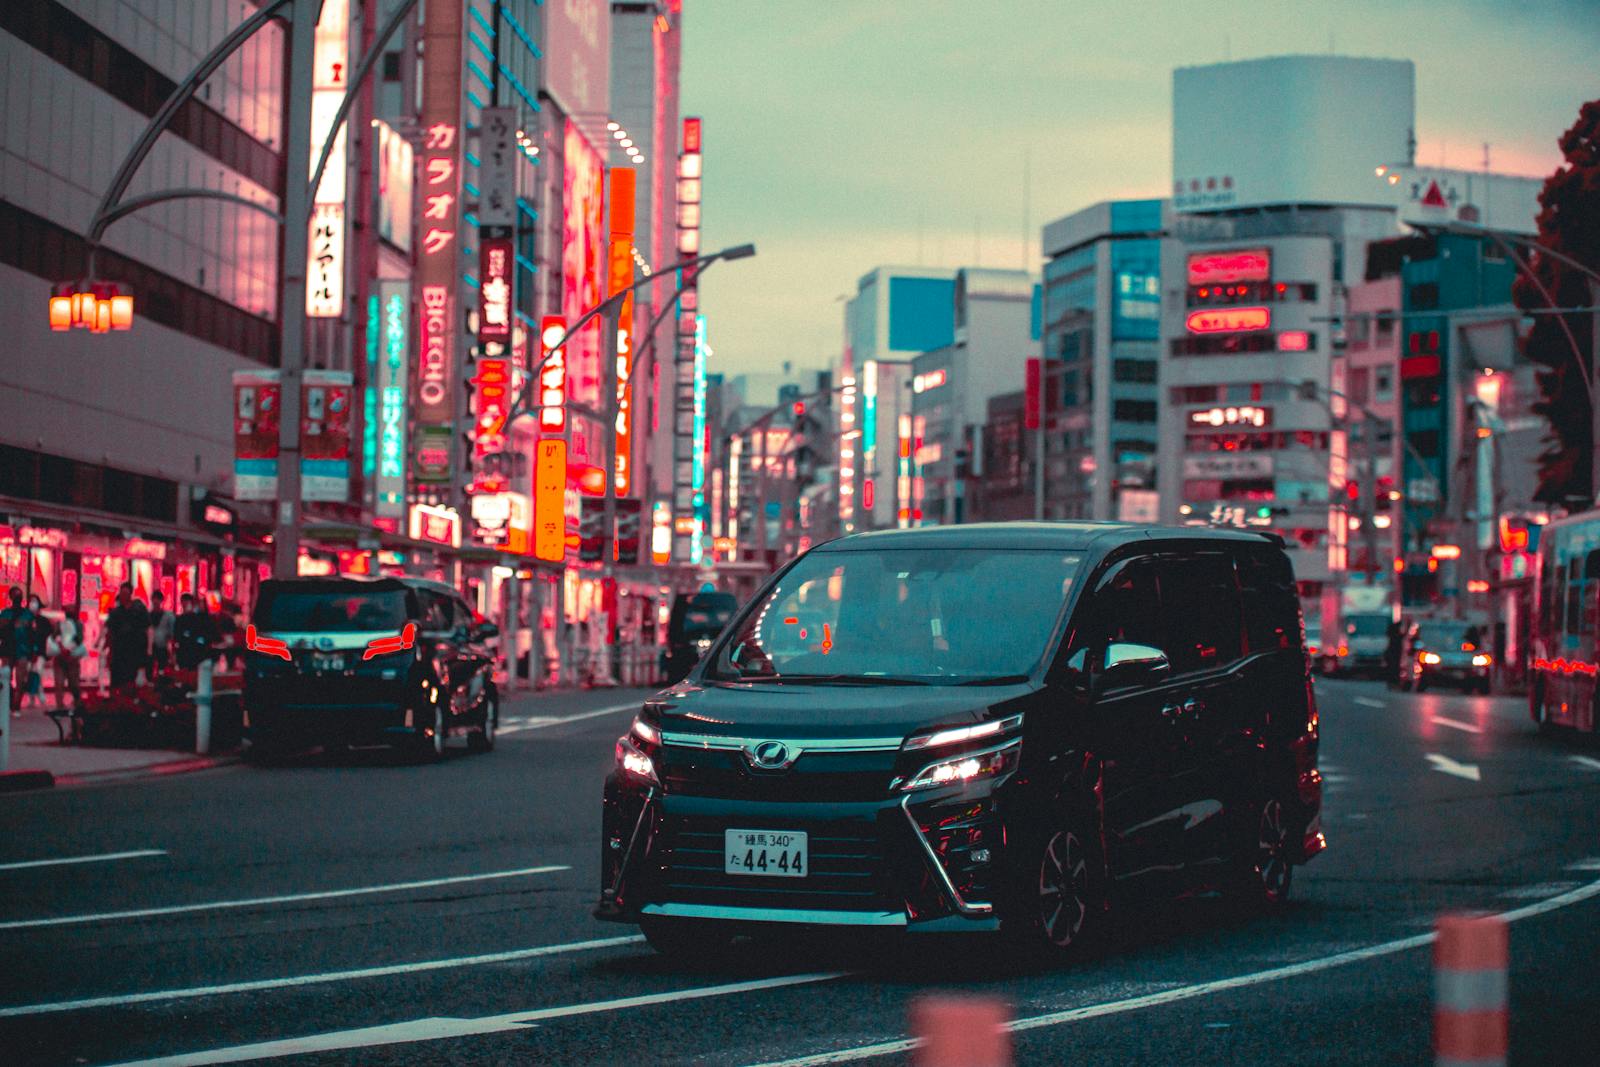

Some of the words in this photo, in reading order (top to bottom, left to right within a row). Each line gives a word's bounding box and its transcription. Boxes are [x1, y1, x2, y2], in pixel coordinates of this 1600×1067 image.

[423, 122, 455, 254] カラオケ
[315, 224, 334, 300] ルノアール
[730, 853, 740, 865] た
[744, 848, 803, 874] 44-44
[745, 834, 767, 846] 練馬
[769, 834, 790, 847] 340
